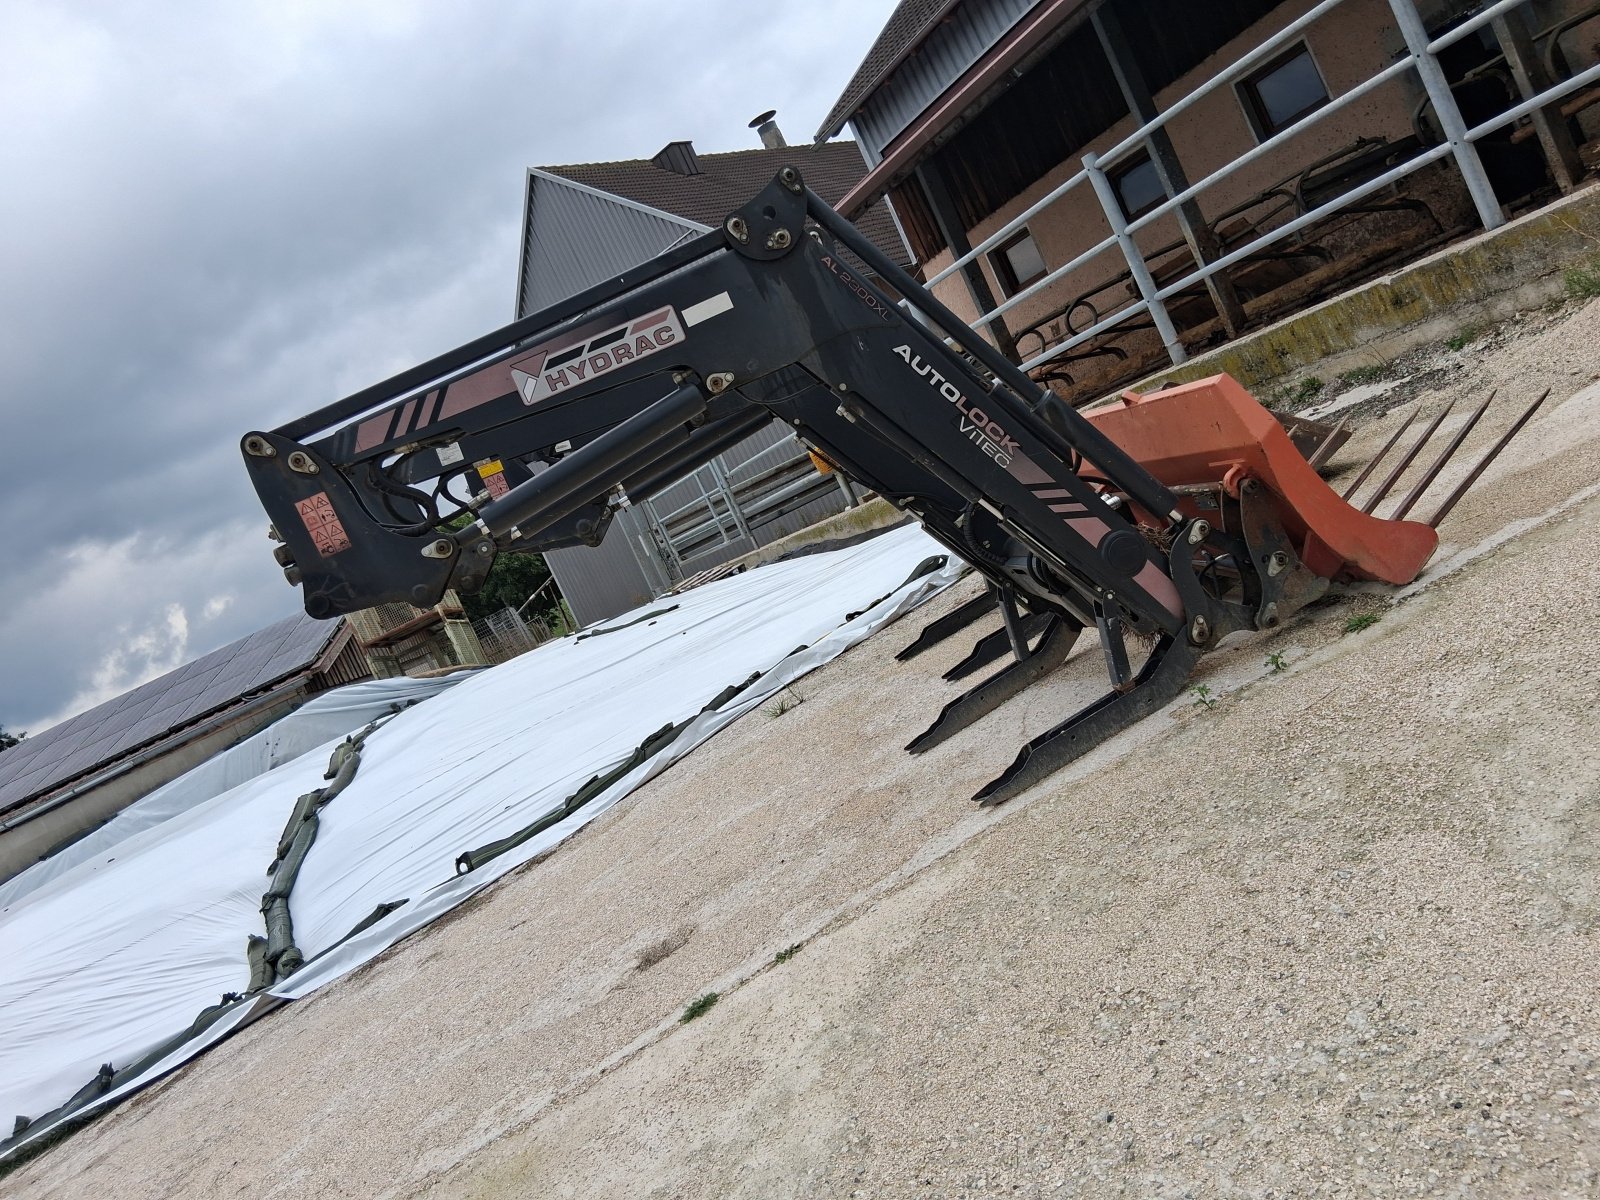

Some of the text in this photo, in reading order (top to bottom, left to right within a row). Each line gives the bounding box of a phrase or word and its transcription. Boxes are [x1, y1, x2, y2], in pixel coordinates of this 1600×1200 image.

[821, 256, 888, 321] AL 2300XL
[545, 326, 675, 391] HYDRAC
[892, 344, 1021, 455] AUTOLOCK
